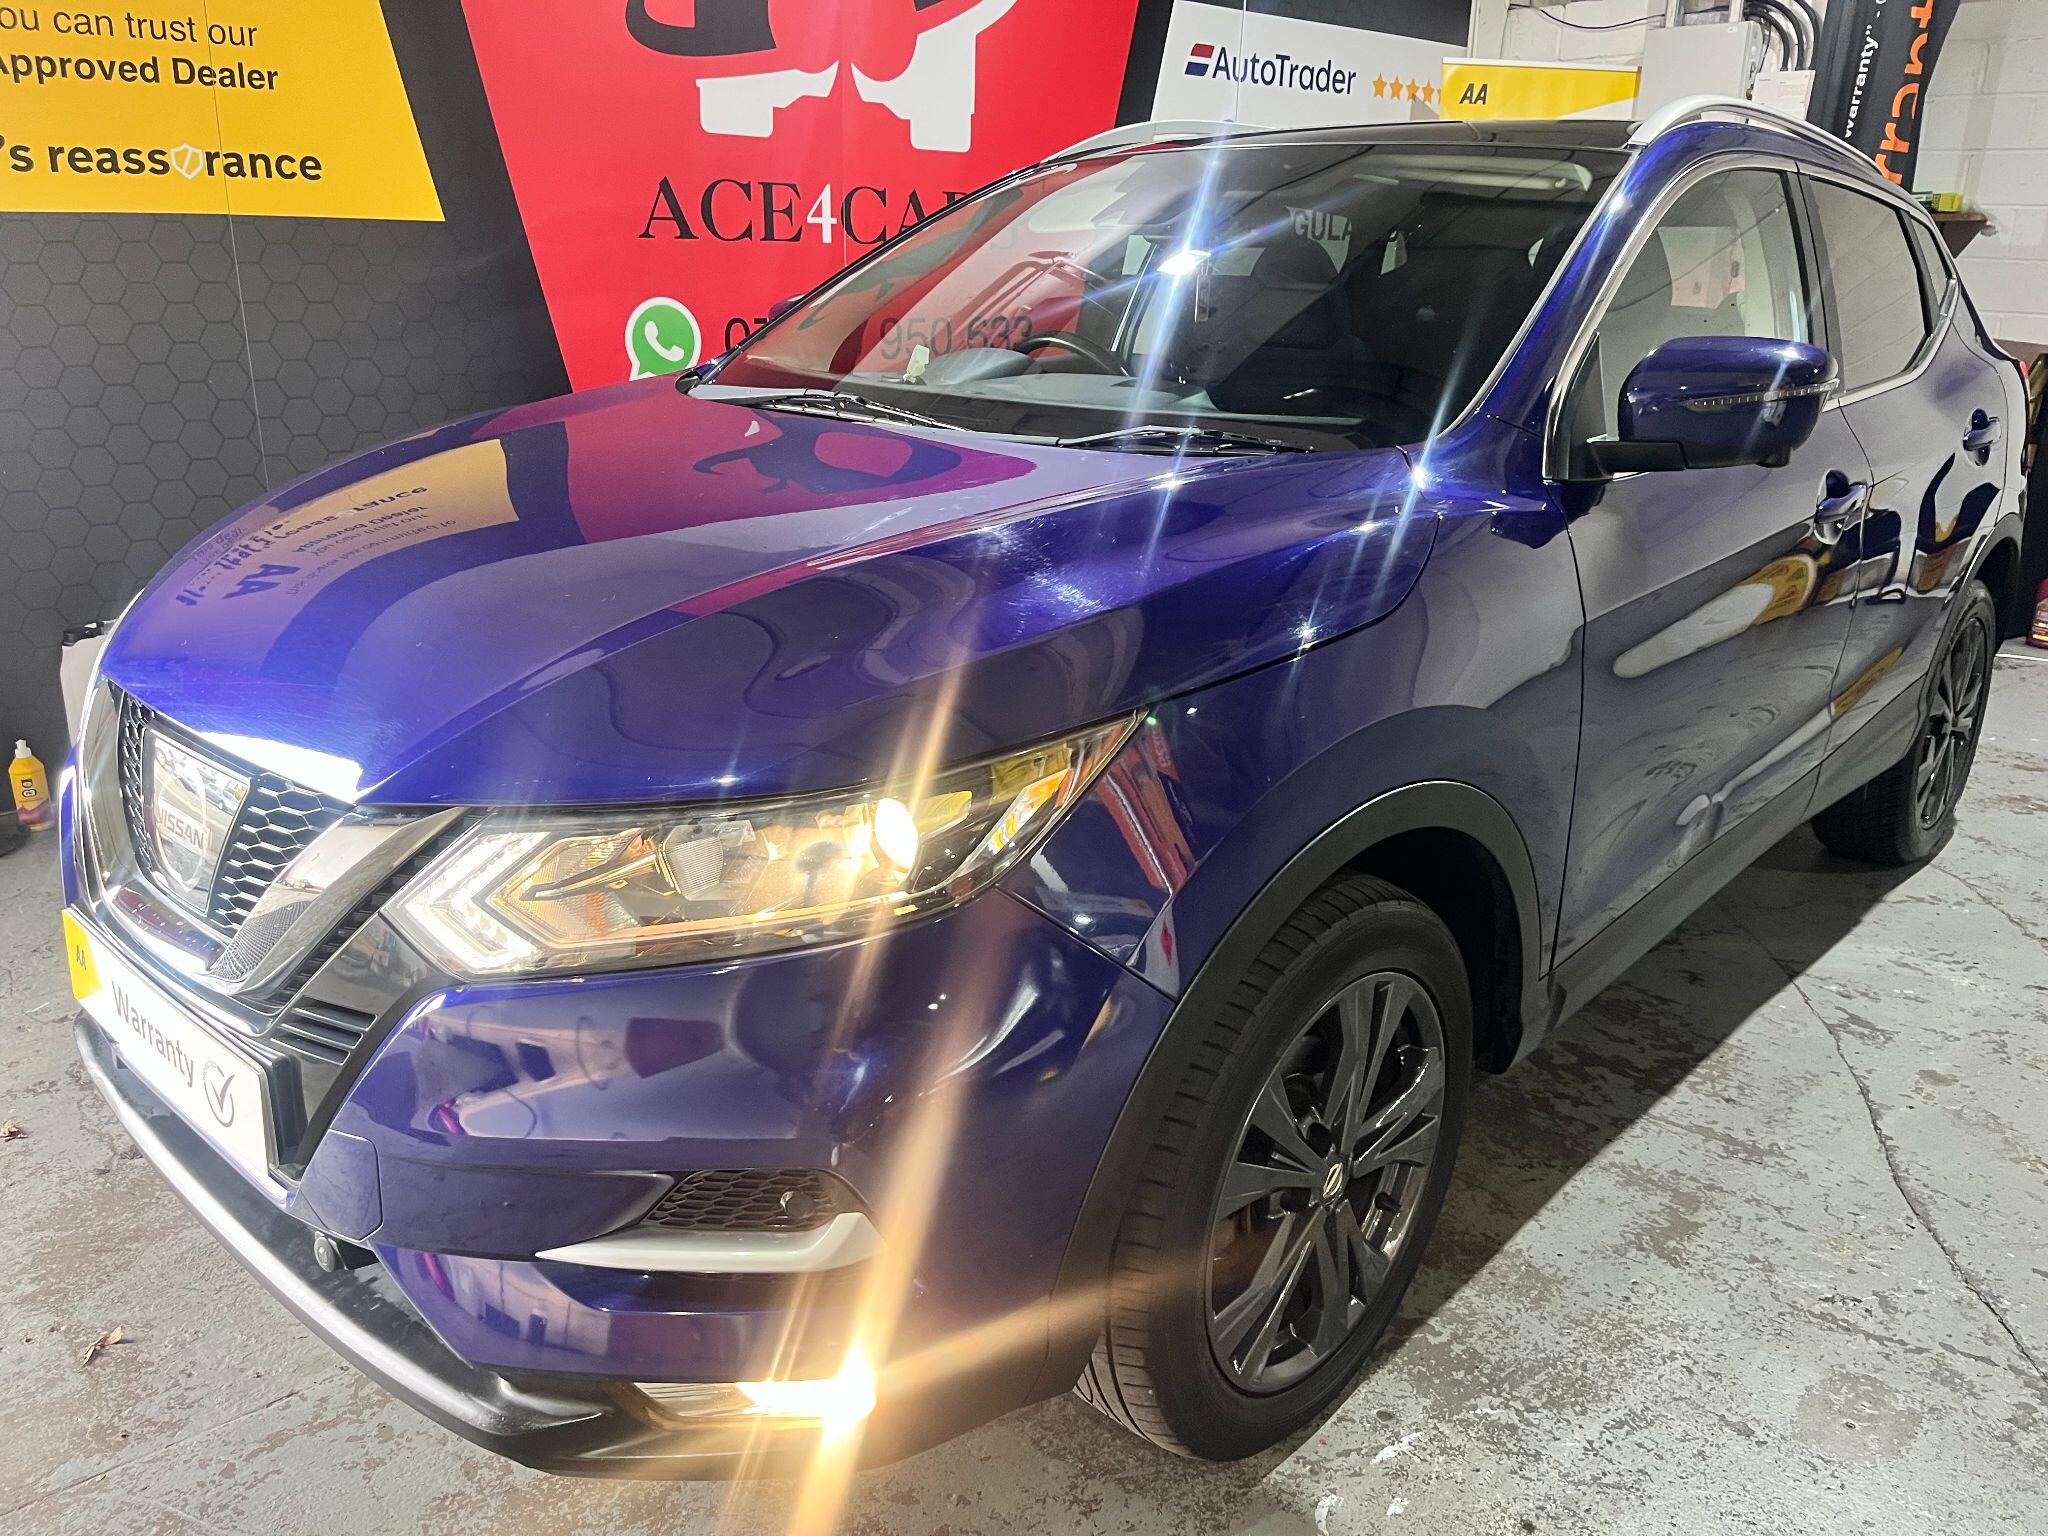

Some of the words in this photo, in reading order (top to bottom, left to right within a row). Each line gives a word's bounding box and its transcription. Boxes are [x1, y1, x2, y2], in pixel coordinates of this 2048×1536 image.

[53, 11, 115, 37] can
[125, 12, 198, 43] trust
[207, 23, 258, 47] our
[171, 56, 279, 91] Dealer
[1212, 46, 1357, 95] AutoTrader
[1459, 83, 1489, 106] AA
[156, 807, 206, 850] NISSAN
[76, 945, 88, 971] AA
[111, 980, 195, 1089] Warranty
